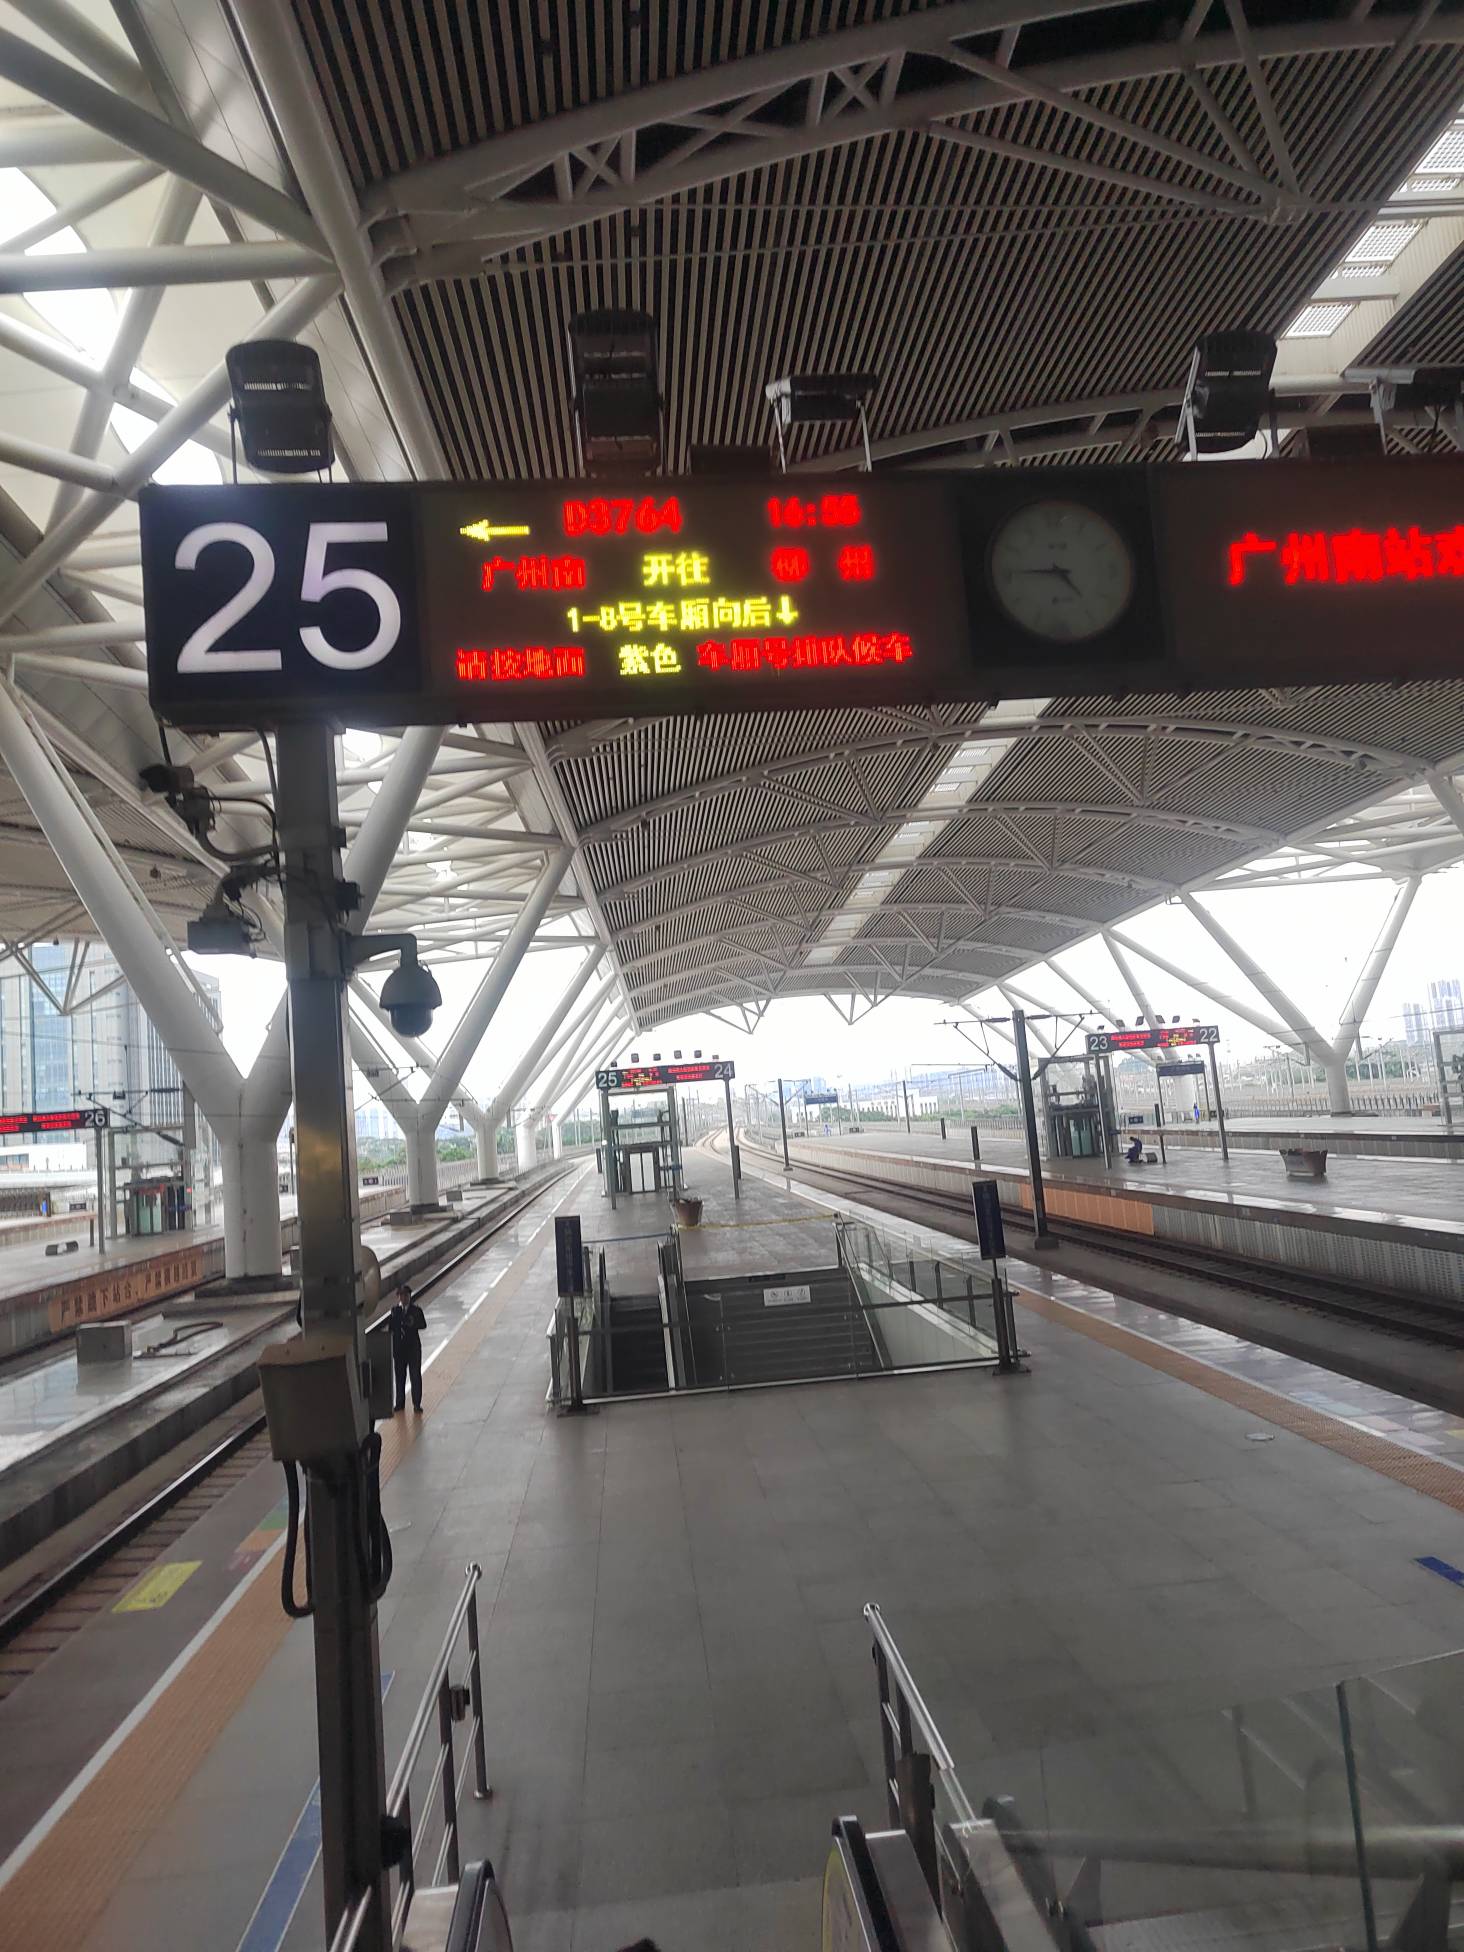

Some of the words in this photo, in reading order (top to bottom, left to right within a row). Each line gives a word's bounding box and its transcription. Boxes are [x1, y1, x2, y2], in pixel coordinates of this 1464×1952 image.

[563, 496, 682, 536] D3764
[482, 554, 586, 592] 广州南
[643, 552, 710, 587] 开往
[175, 521, 400, 674] 25
[618, 643, 681, 675] 紫色
[1090, 1036, 1108, 1050] 23
[1200, 1028, 1218, 1042] 22
[598, 1072, 618, 1087] 25
[715, 1064, 733, 1078] 24
[85, 1110, 106, 1127] 26
